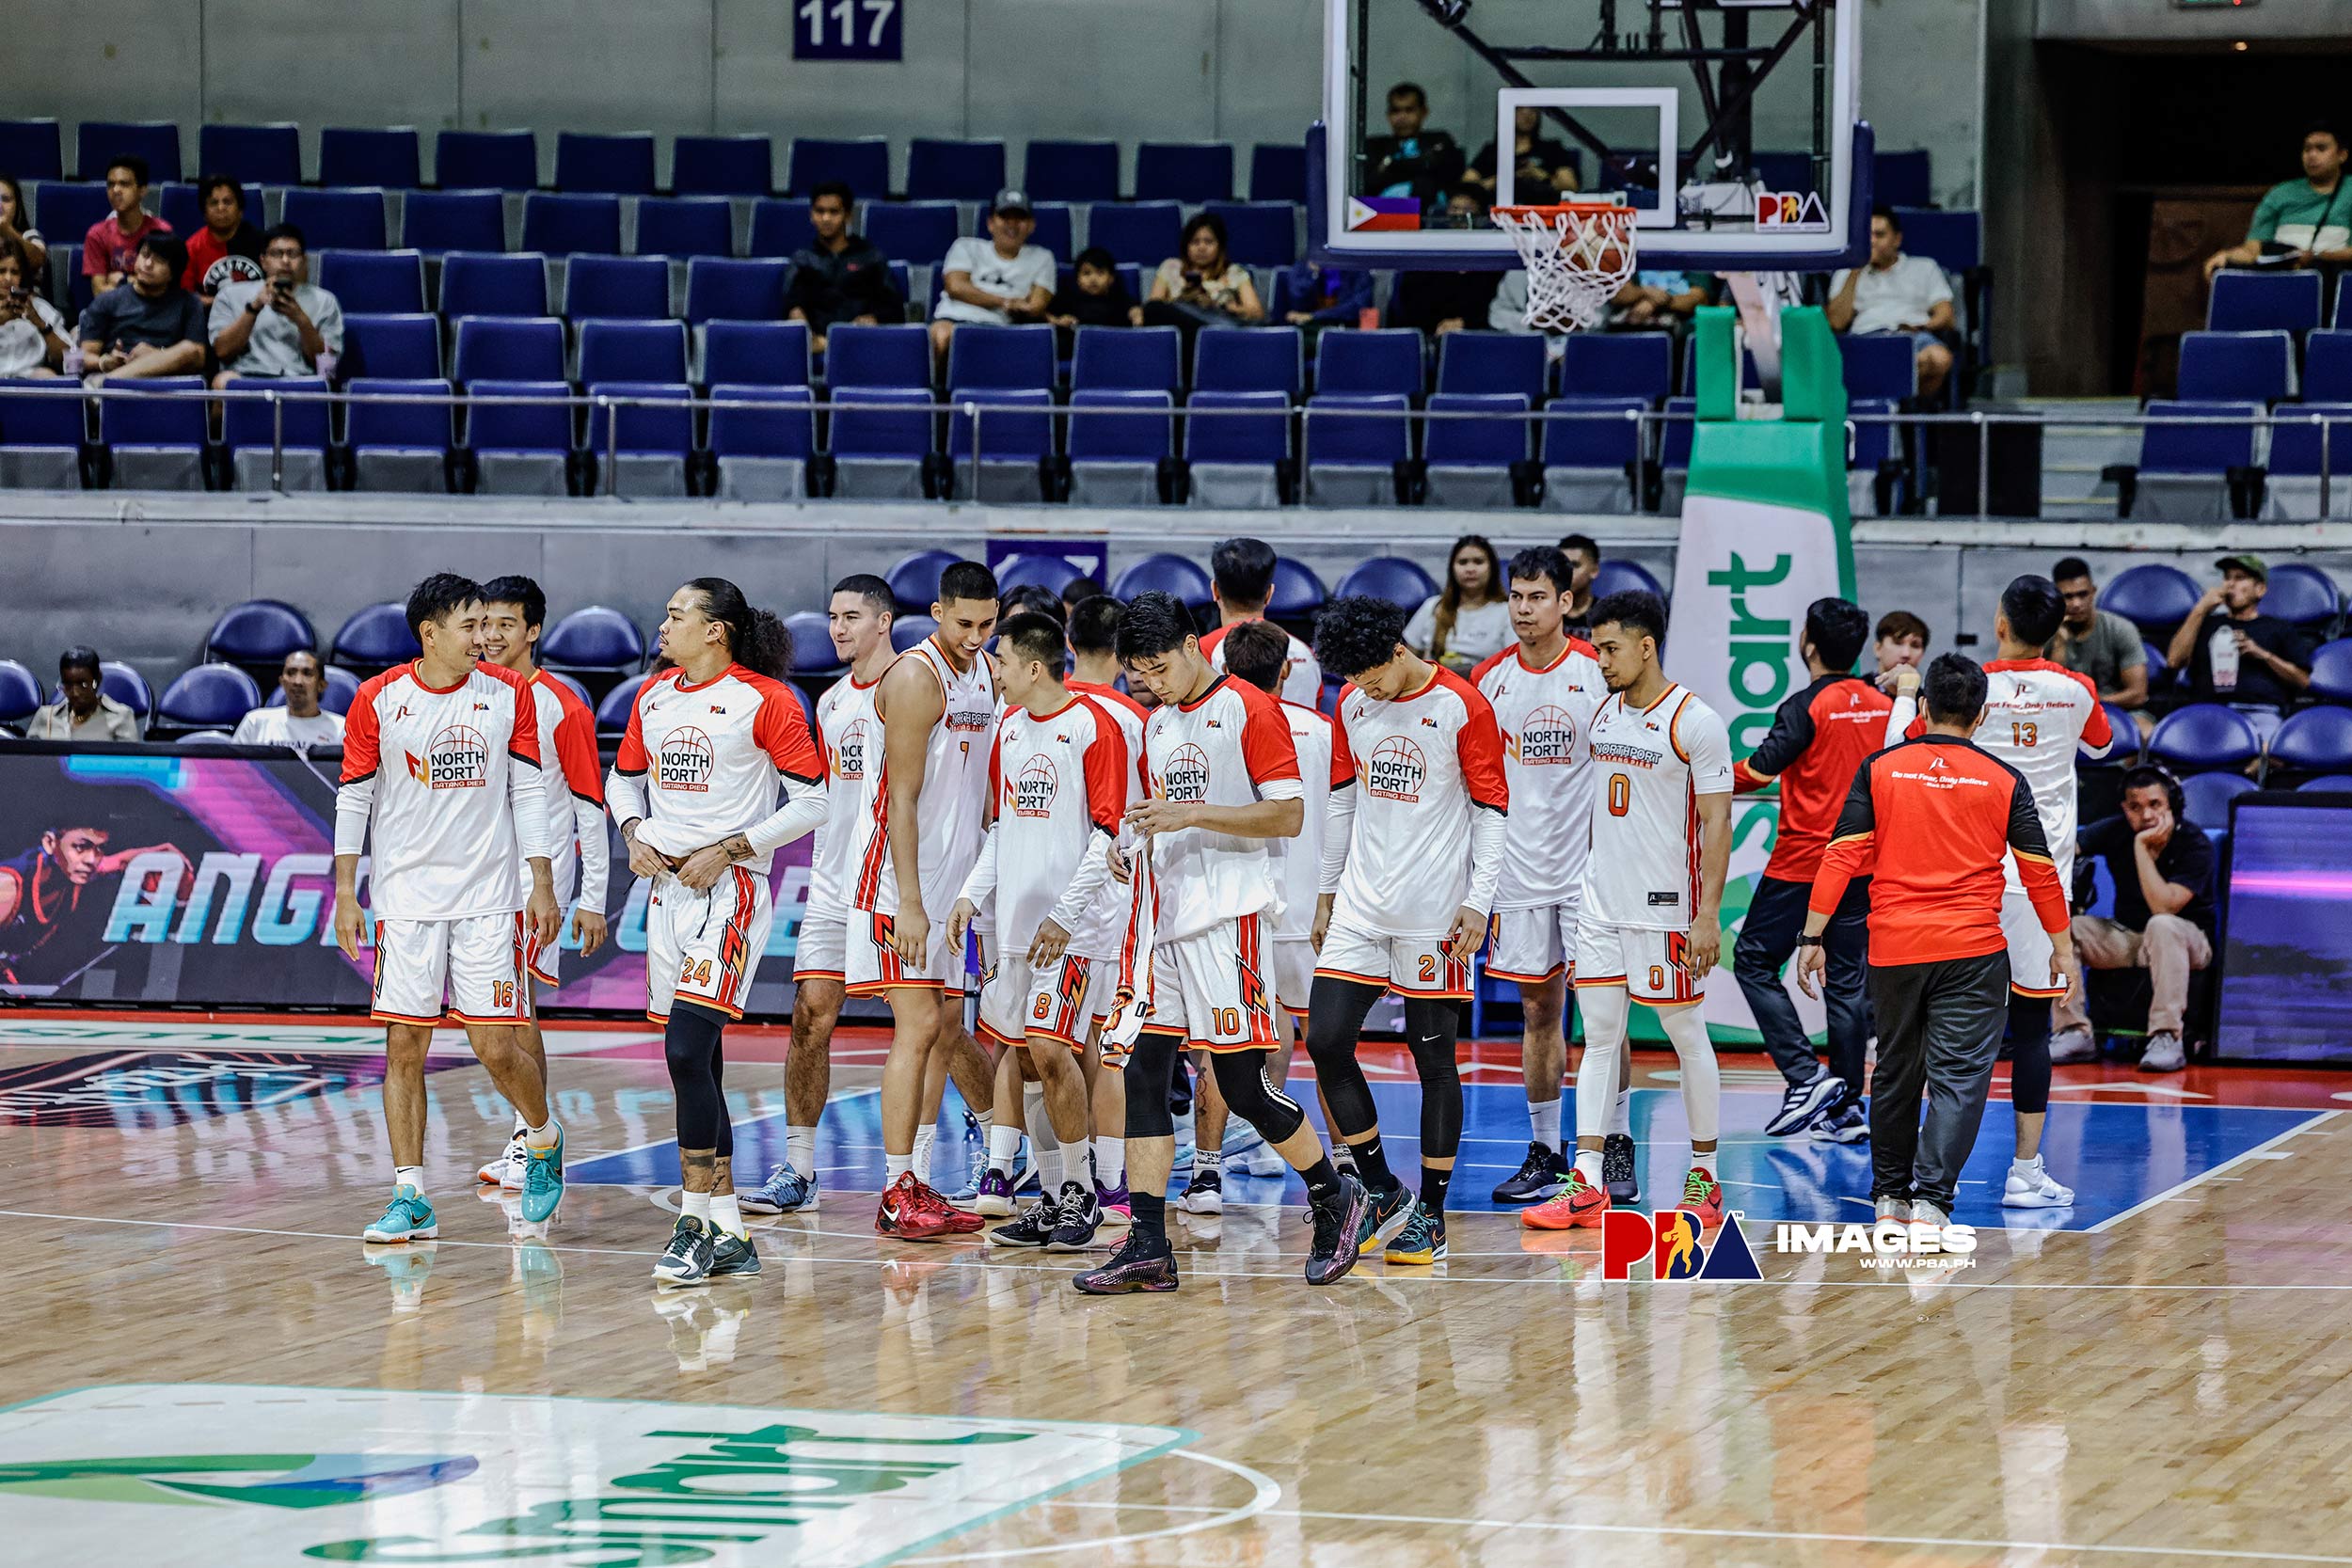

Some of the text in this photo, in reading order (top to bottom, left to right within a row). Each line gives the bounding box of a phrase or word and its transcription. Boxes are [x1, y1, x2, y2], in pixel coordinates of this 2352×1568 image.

[800, 0, 896, 46] 117
[1756, 192, 1830, 226] PBA
[1523, 731, 1572, 743] NORTH
[2012, 722, 2037, 747] 13
[432, 751, 485, 767] NORTH
[661, 752, 709, 768] NORTH
[961, 741, 970, 774] 7
[1523, 744, 1562, 757] PORT
[1595, 743, 1662, 765] NORTHPORT
[432, 767, 475, 782] PORT
[661, 768, 698, 782] PORT
[1167, 770, 1206, 785] NORTH
[1372, 760, 1422, 780] NORTH
[1166, 785, 1201, 800] PORT
[1370, 775, 1409, 792] PORT
[1609, 772, 1630, 817] 0
[1399, 794, 1418, 802] PIER
[680, 957, 712, 988] 24
[1418, 954, 1436, 982] 2
[1649, 965, 1664, 990] 0
[493, 980, 514, 1008] 16
[1033, 992, 1052, 1020] 8
[1212, 1007, 1240, 1036] 10
